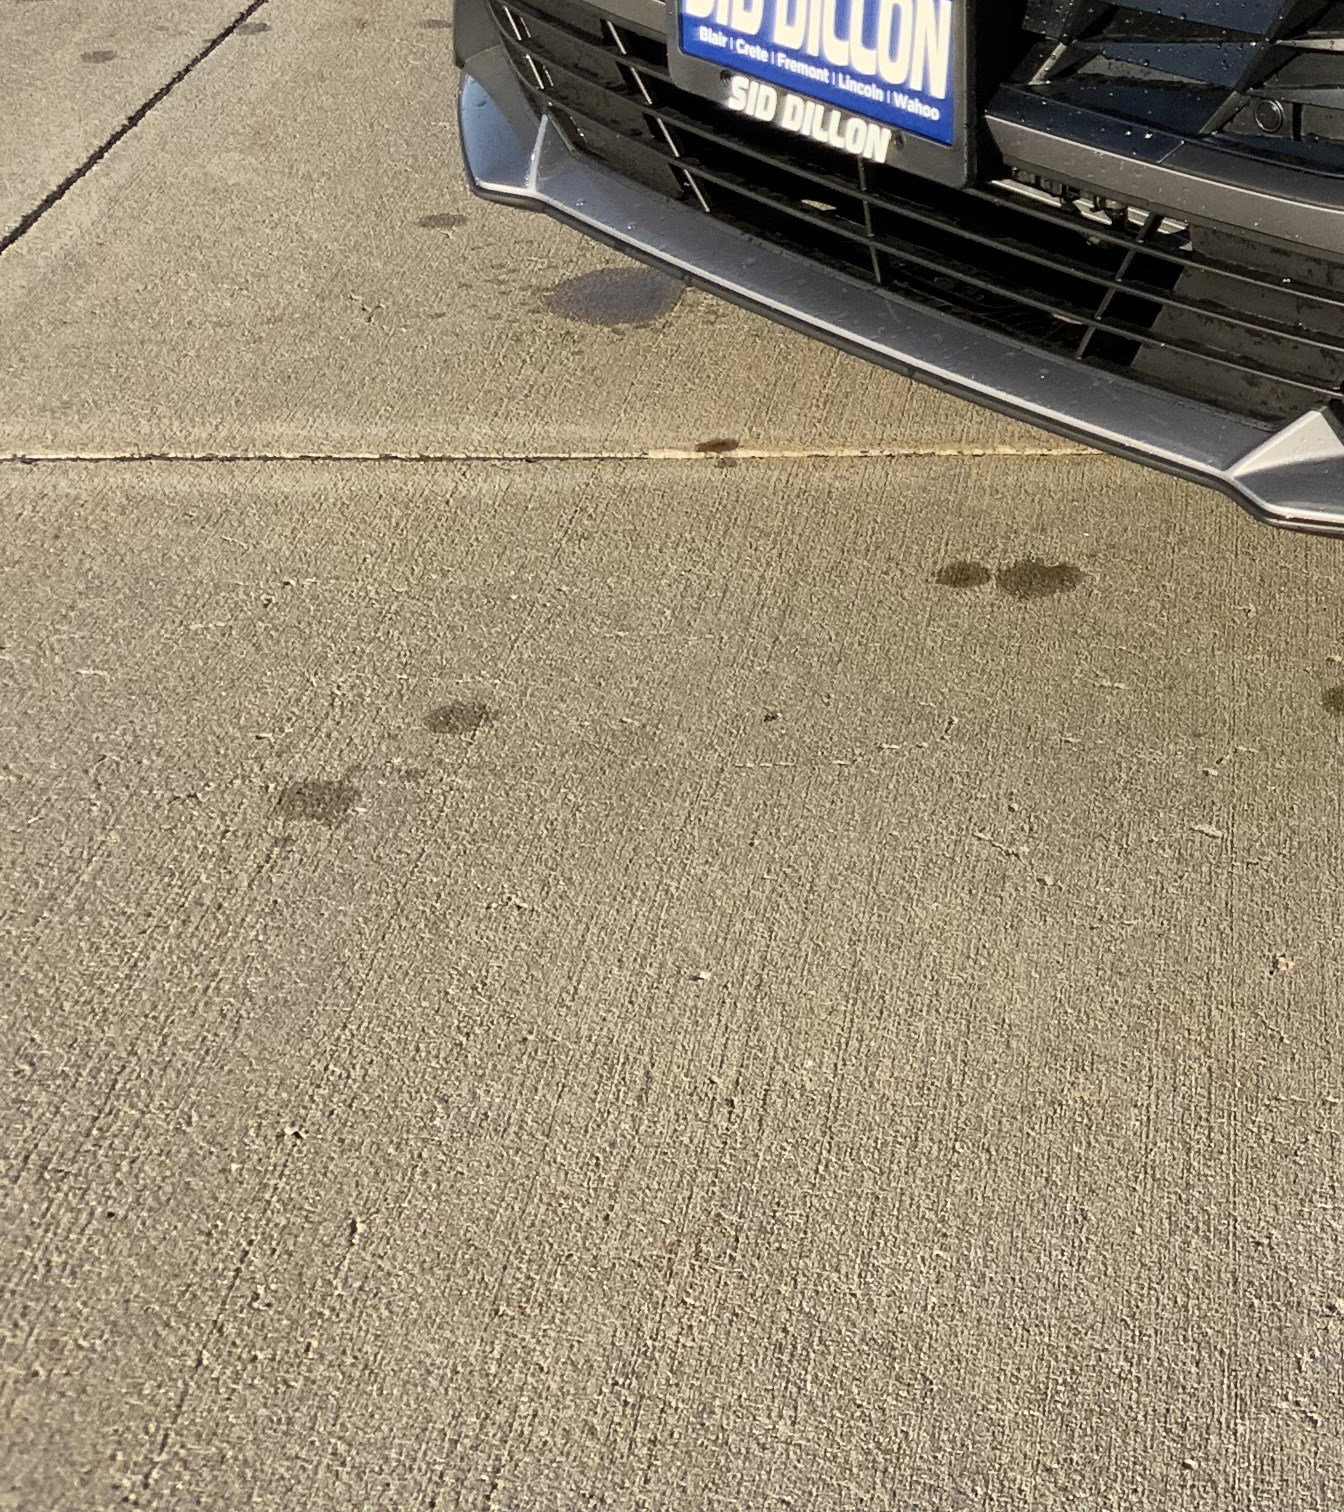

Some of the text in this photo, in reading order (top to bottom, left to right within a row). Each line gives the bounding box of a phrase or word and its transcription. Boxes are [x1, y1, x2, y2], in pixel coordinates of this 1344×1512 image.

[699, 25, 941, 121] Blair Crete Fremont Lincoln Wahoo
[727, 75, 893, 164] SID DILLON
